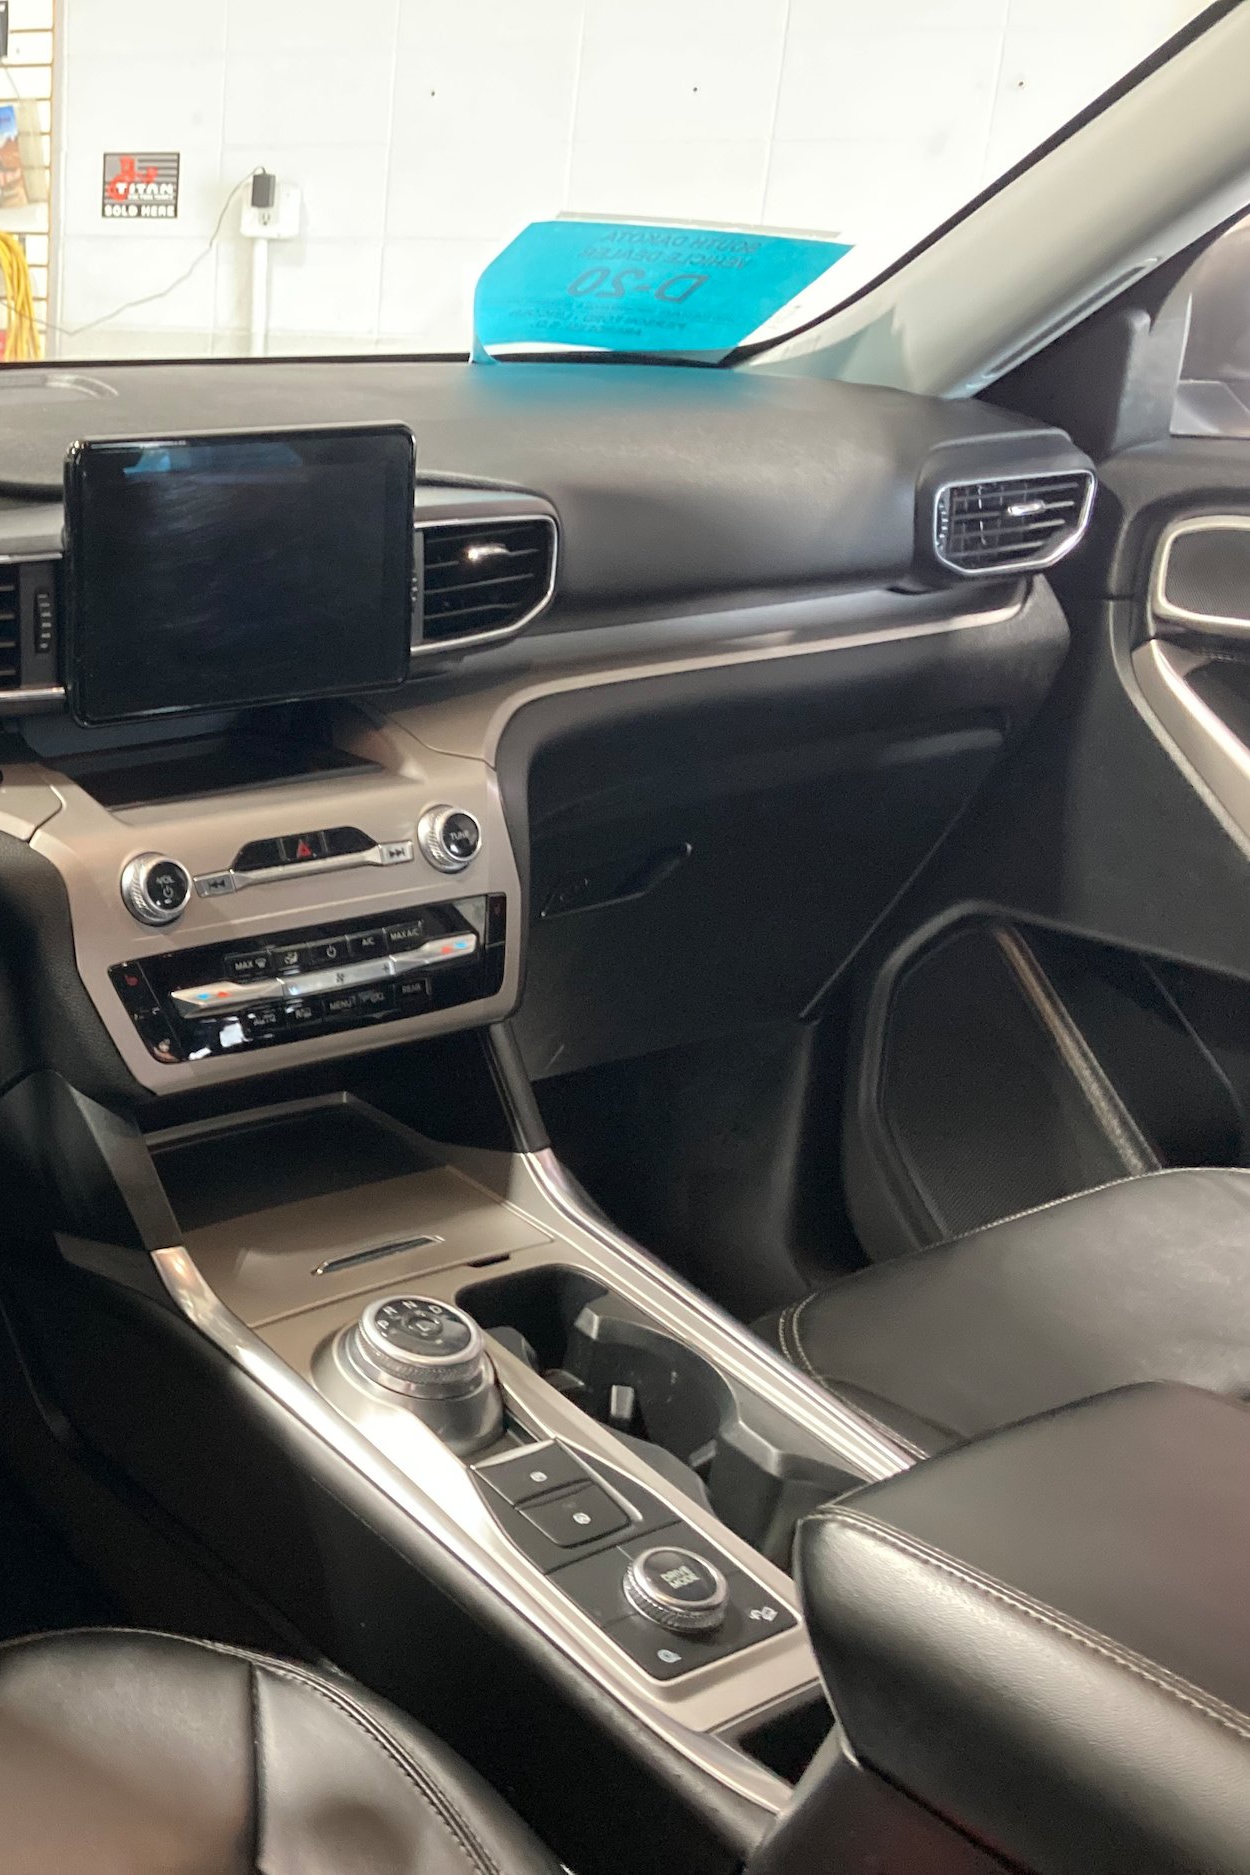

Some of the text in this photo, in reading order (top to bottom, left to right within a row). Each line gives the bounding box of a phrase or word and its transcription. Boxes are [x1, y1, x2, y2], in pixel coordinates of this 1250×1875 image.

[115, 182, 174, 195] TITAN
[104, 204, 175, 217] SOLD HERE
[450, 830, 470, 841] TUNE
[156, 874, 174, 886] VOL
[390, 928, 420, 941] MAX A/C
[361, 936, 374, 947] A/C
[234, 959, 254, 970] MAX
[402, 983, 422, 995] REAR
[402, 1300, 418, 1310] N
[428, 1304, 443, 1315] D
[377, 1320, 389, 1330] P
[660, 1564, 696, 1583] DRIVE
[668, 1574, 700, 1590] MODE
